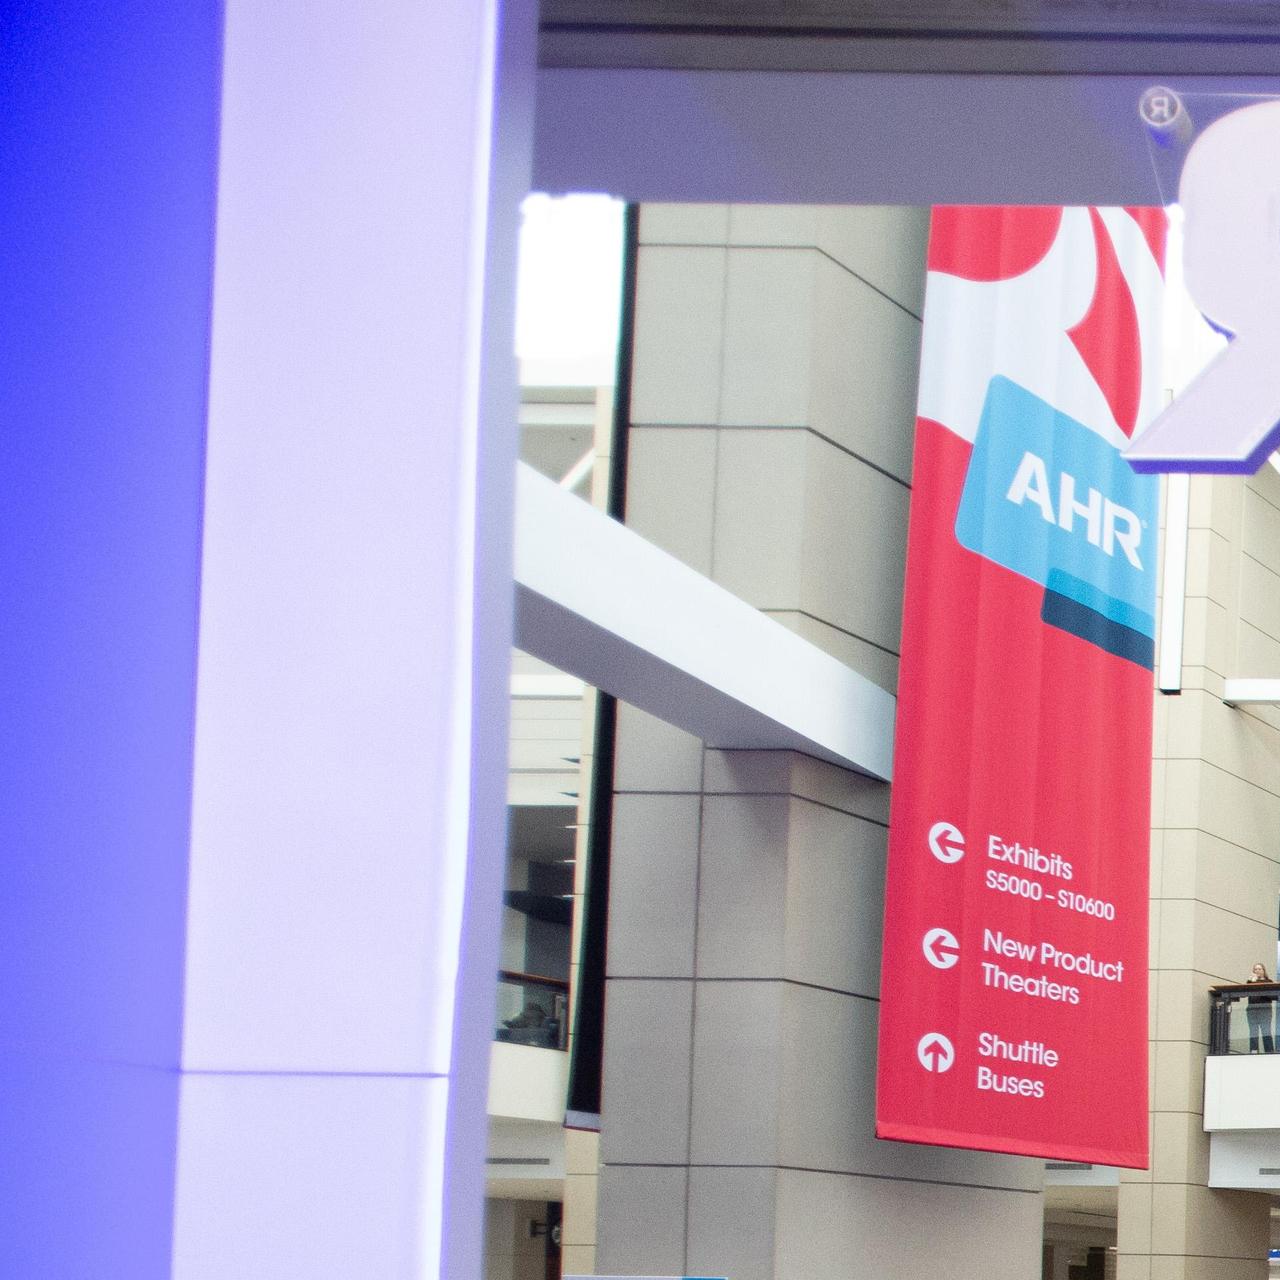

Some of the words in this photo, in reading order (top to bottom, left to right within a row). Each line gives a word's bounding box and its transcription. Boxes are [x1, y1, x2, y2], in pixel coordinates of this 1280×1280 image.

[1006, 451, 1145, 571] AHR
[987, 835, 1073, 880] Exhibits
[985, 870, 1042, 900] S5000
[1057, 889, 1115, 921] S10600
[983, 928, 1036, 961] New
[1040, 942, 1124, 982] Product
[981, 962, 1080, 1005] Theaters
[978, 1032, 1059, 1067] Shuttle
[977, 1066, 1045, 1098] Buses
